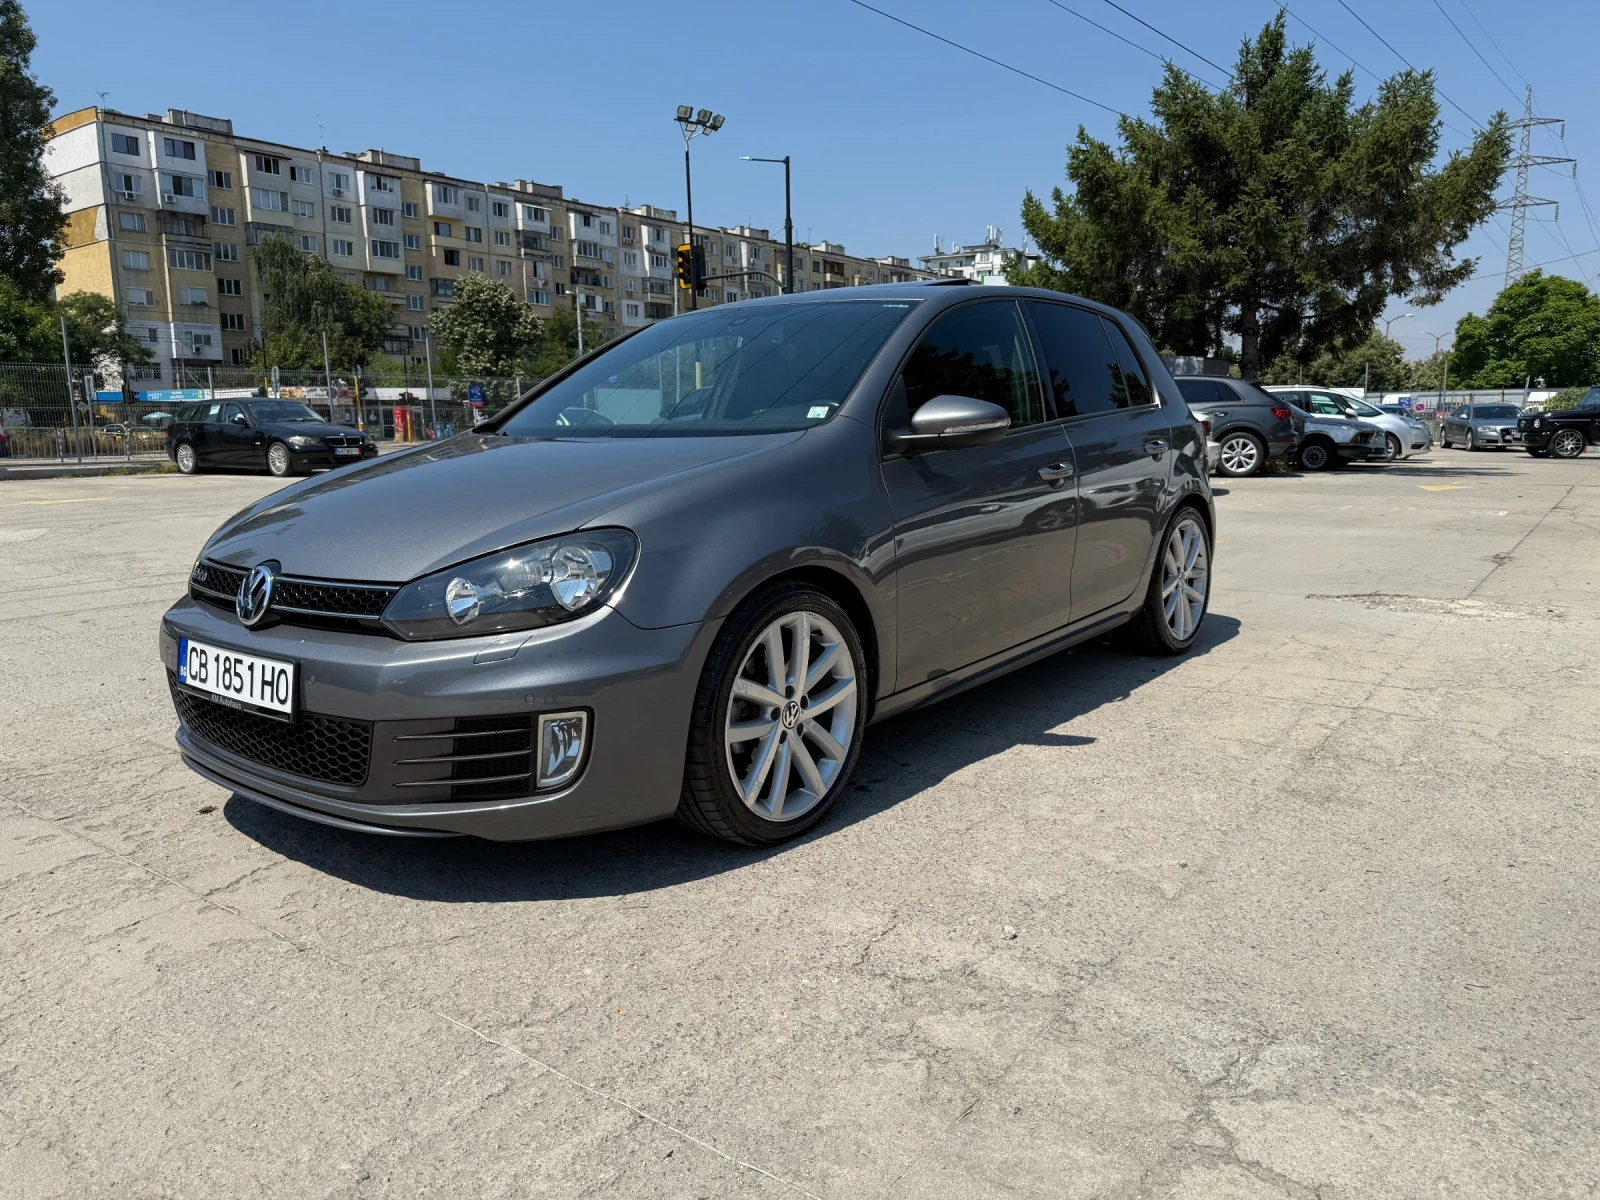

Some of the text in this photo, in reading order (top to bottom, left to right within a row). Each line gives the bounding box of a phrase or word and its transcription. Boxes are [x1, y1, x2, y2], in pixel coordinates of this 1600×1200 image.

[189, 646, 289, 705] CB 1851 HO
